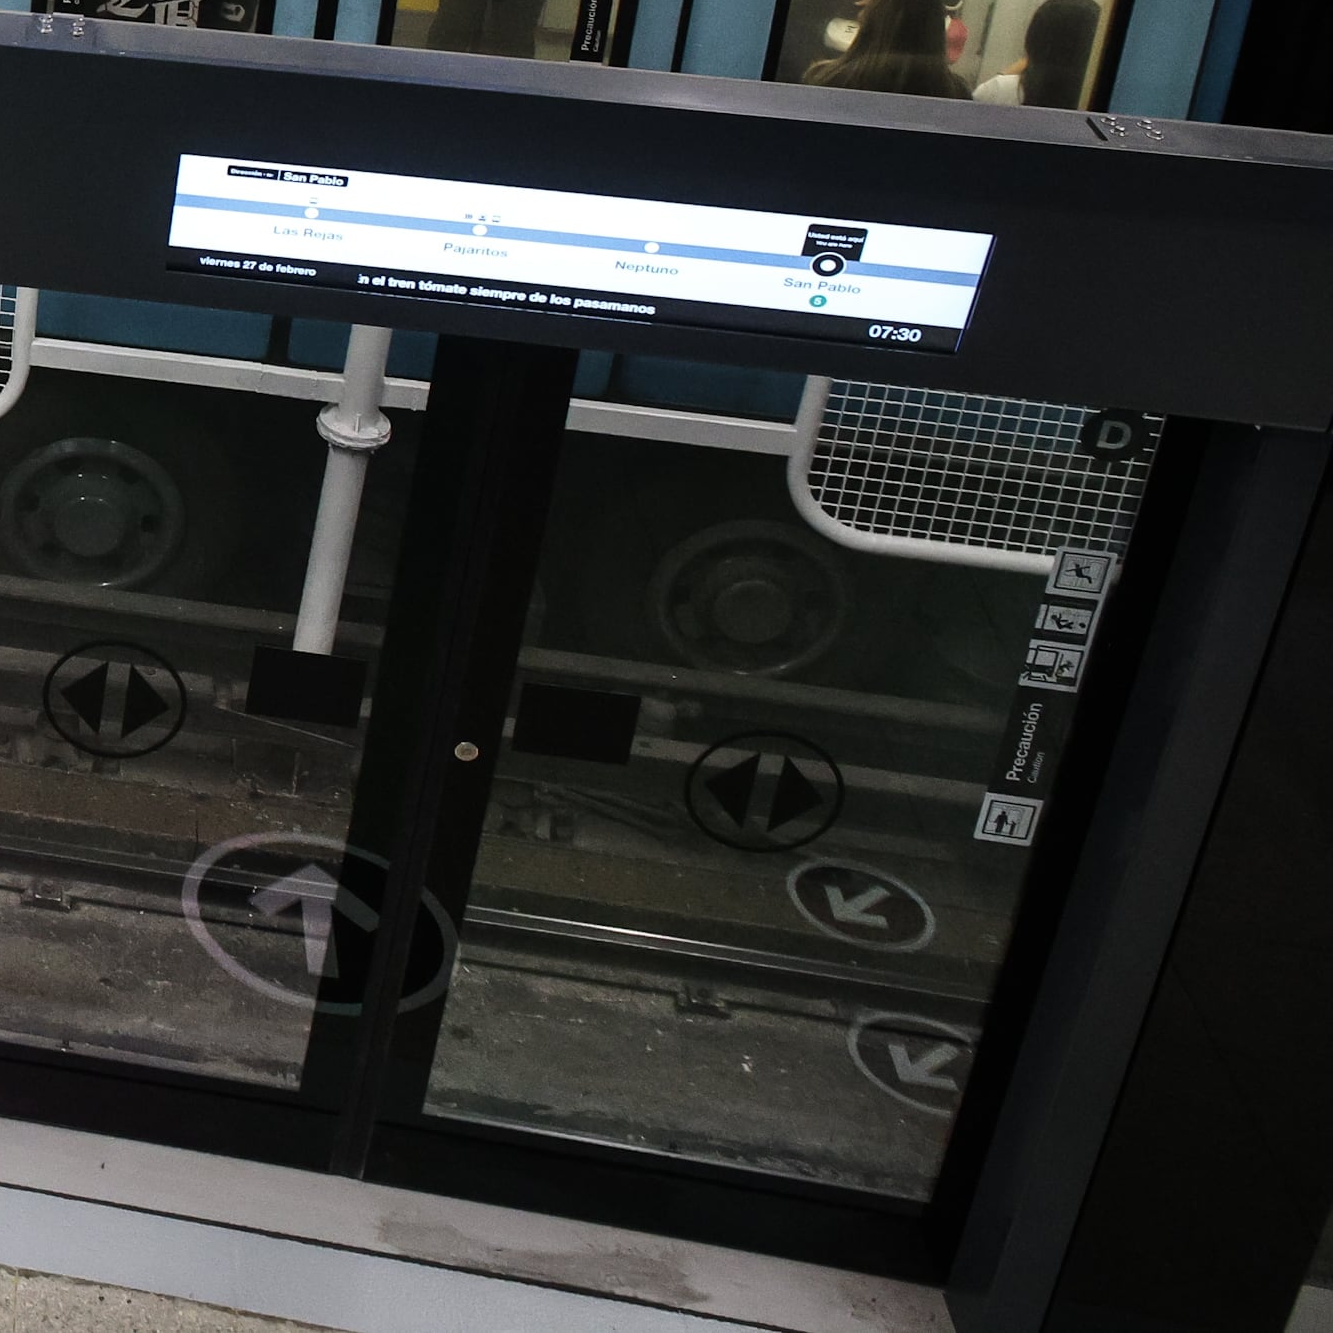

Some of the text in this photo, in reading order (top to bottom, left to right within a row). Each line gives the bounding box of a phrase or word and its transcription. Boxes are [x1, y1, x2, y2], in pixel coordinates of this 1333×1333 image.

[283, 171, 344, 186] San Pablo
[273, 225, 343, 241] Las Rejas
[444, 242, 509, 258] Pajaritos
[199, 255, 317, 277] viernes 27 de febrero
[614, 260, 679, 276] Neptuno
[372, 275, 656, 315] el tren tómate siempre de los pasamanos
[783, 277, 861, 295] San Pablo
[868, 323, 922, 343] 07:30
[1096, 419, 1133, 449] D
[1005, 702, 1043, 782] Precaución
[1027, 751, 1045, 784] Caution
